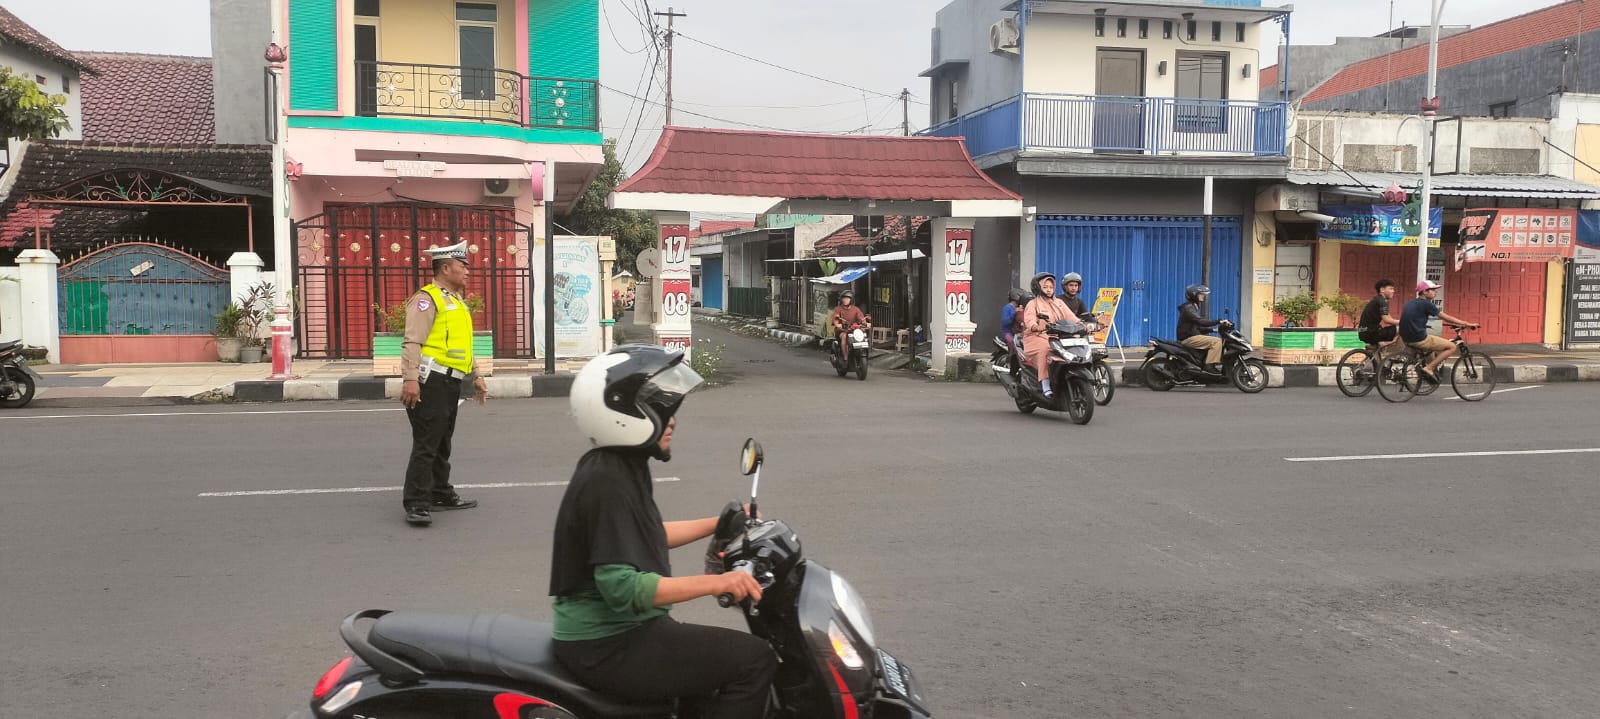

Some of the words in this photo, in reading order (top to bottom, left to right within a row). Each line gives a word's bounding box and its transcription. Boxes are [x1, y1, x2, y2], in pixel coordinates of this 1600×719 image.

[664, 236, 686, 264] 17
[948, 239, 968, 266] 17
[663, 289, 689, 316] 08
[946, 291, 969, 316] 08
[946, 338, 968, 350] 2025
